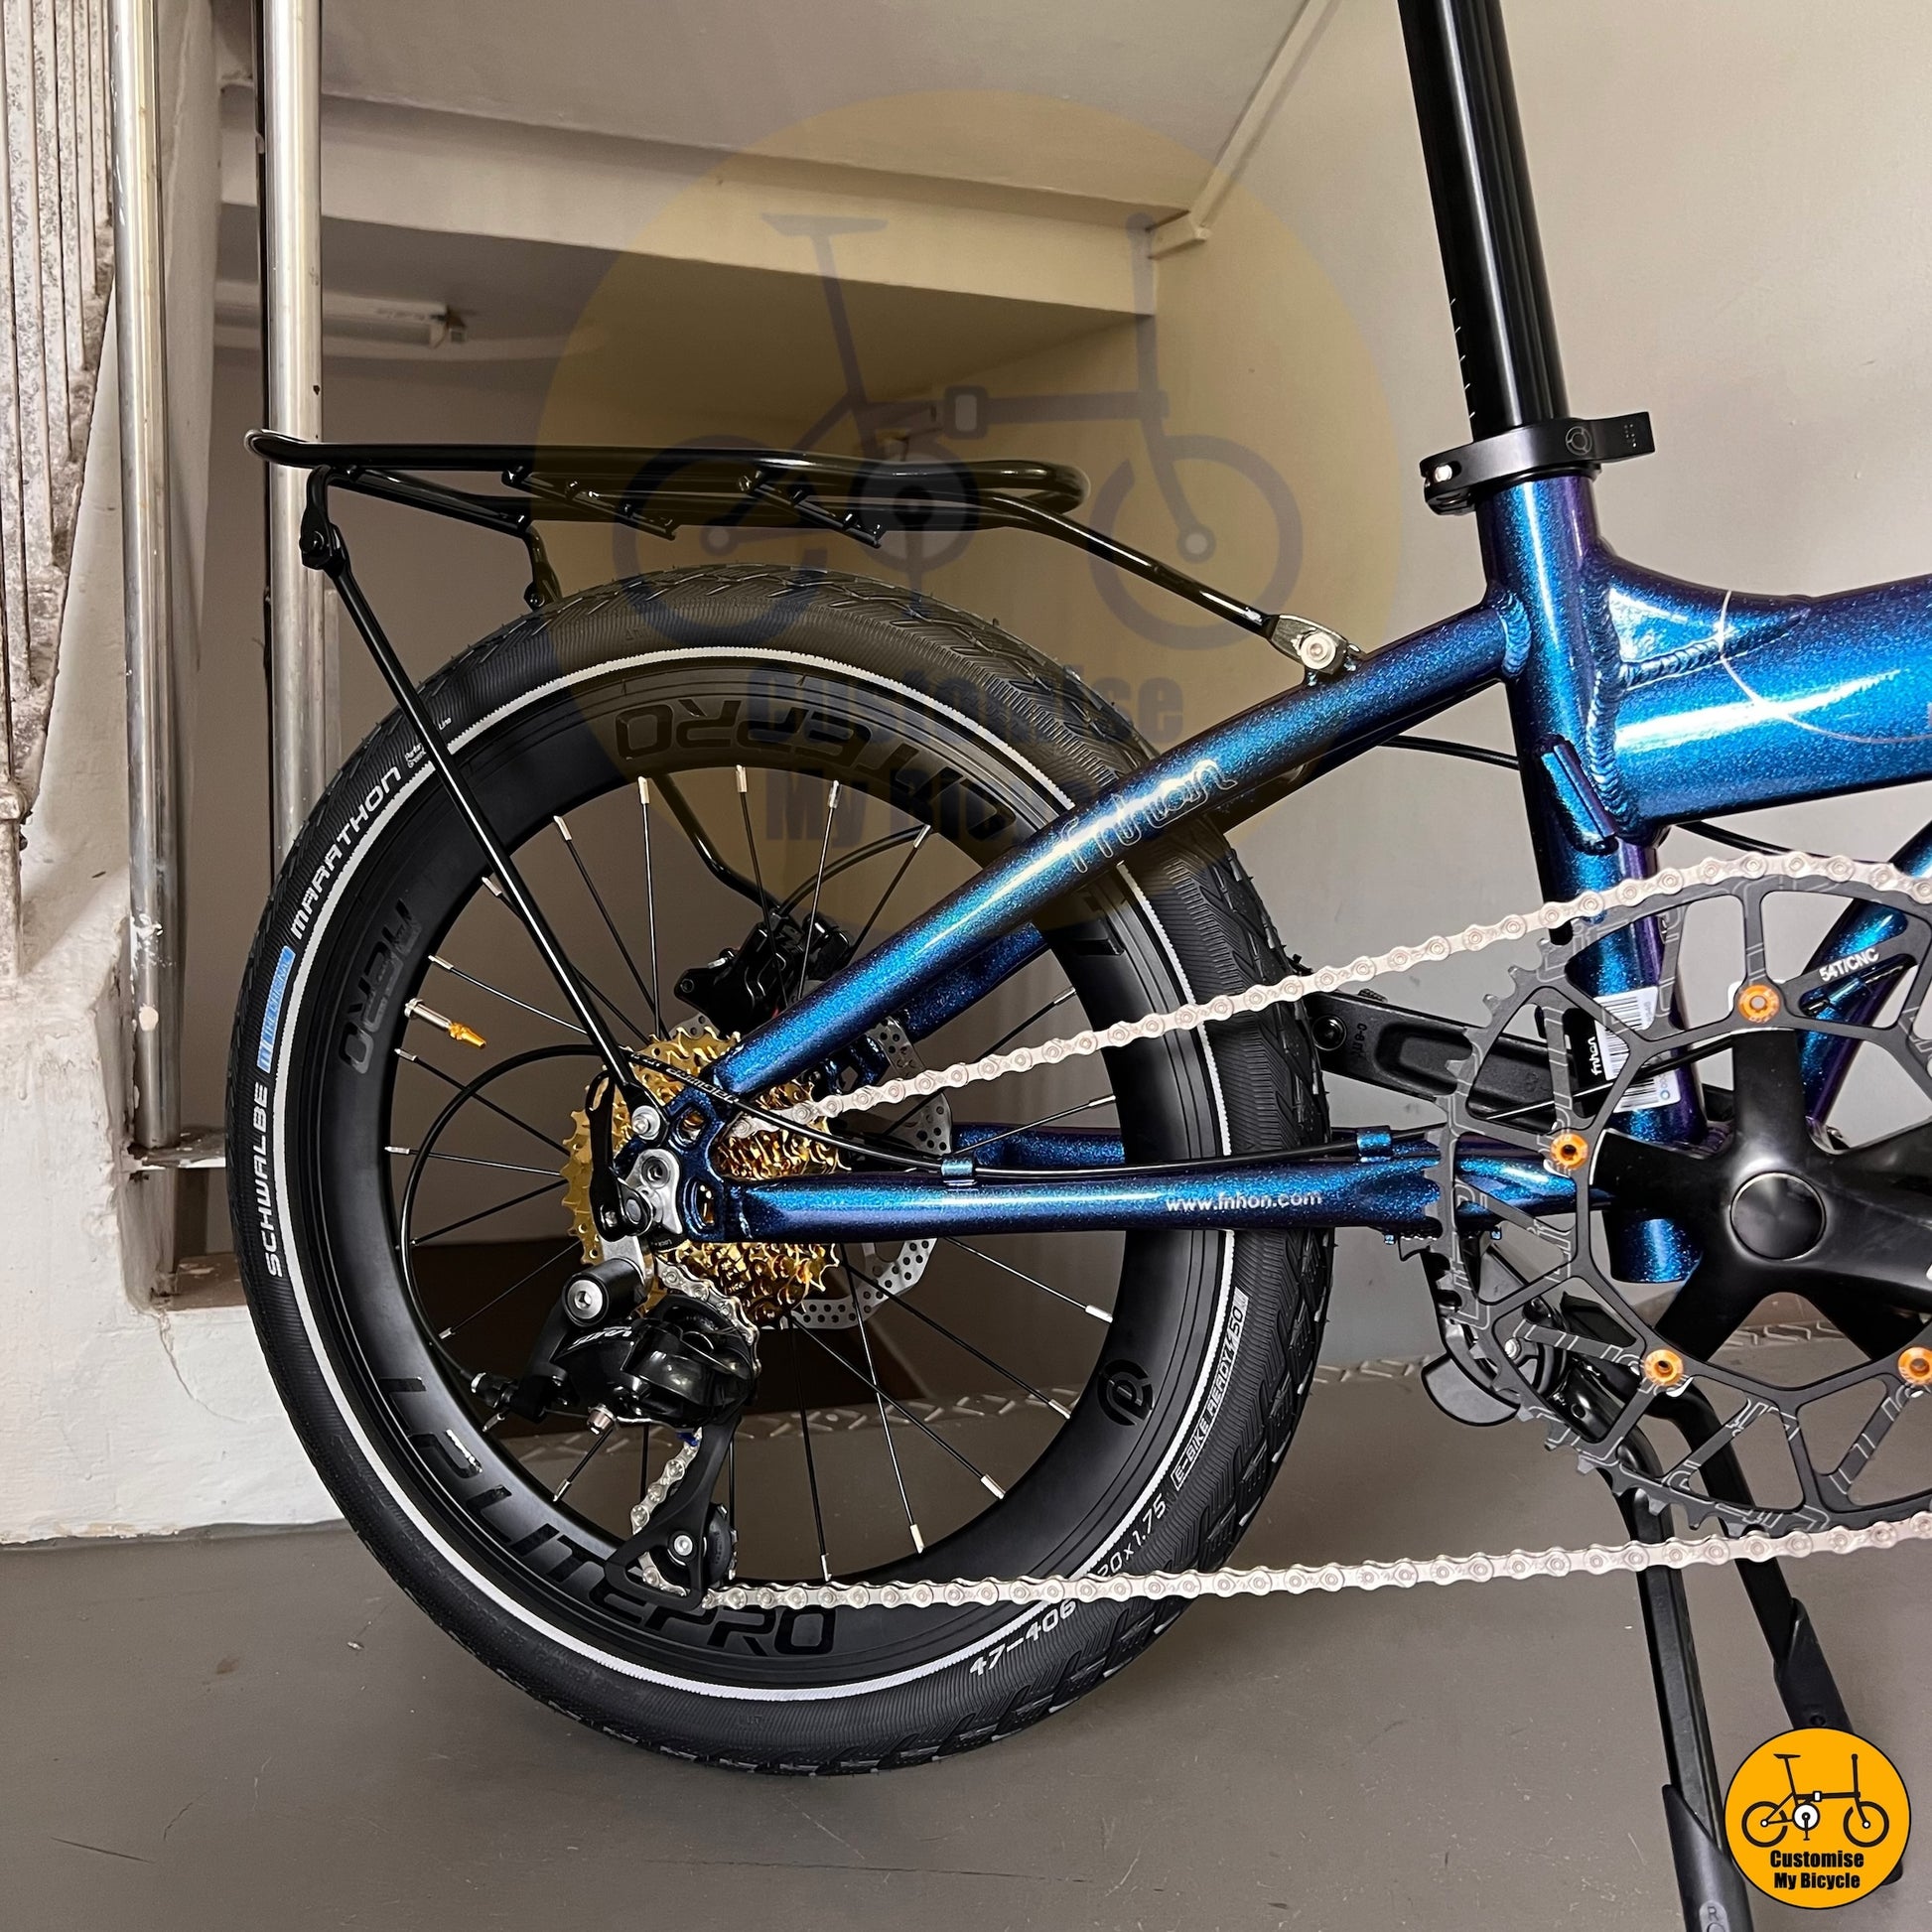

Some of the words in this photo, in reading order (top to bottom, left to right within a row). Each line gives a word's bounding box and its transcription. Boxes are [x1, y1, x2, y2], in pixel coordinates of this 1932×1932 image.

[291, 766, 401, 939] MARATHON
[1819, 947, 1880, 982] 54T/CNC
[253, 1081, 283, 1278] SCHWALBE
[1166, 1191, 1322, 1212] www.fnhon.com
[1174, 1419, 1210, 1483] E-BIKE
[1206, 1353, 1233, 1418] READY
[969, 1599, 1077, 1676] 47-406
[1708, 1906, 1719, 1921] R
